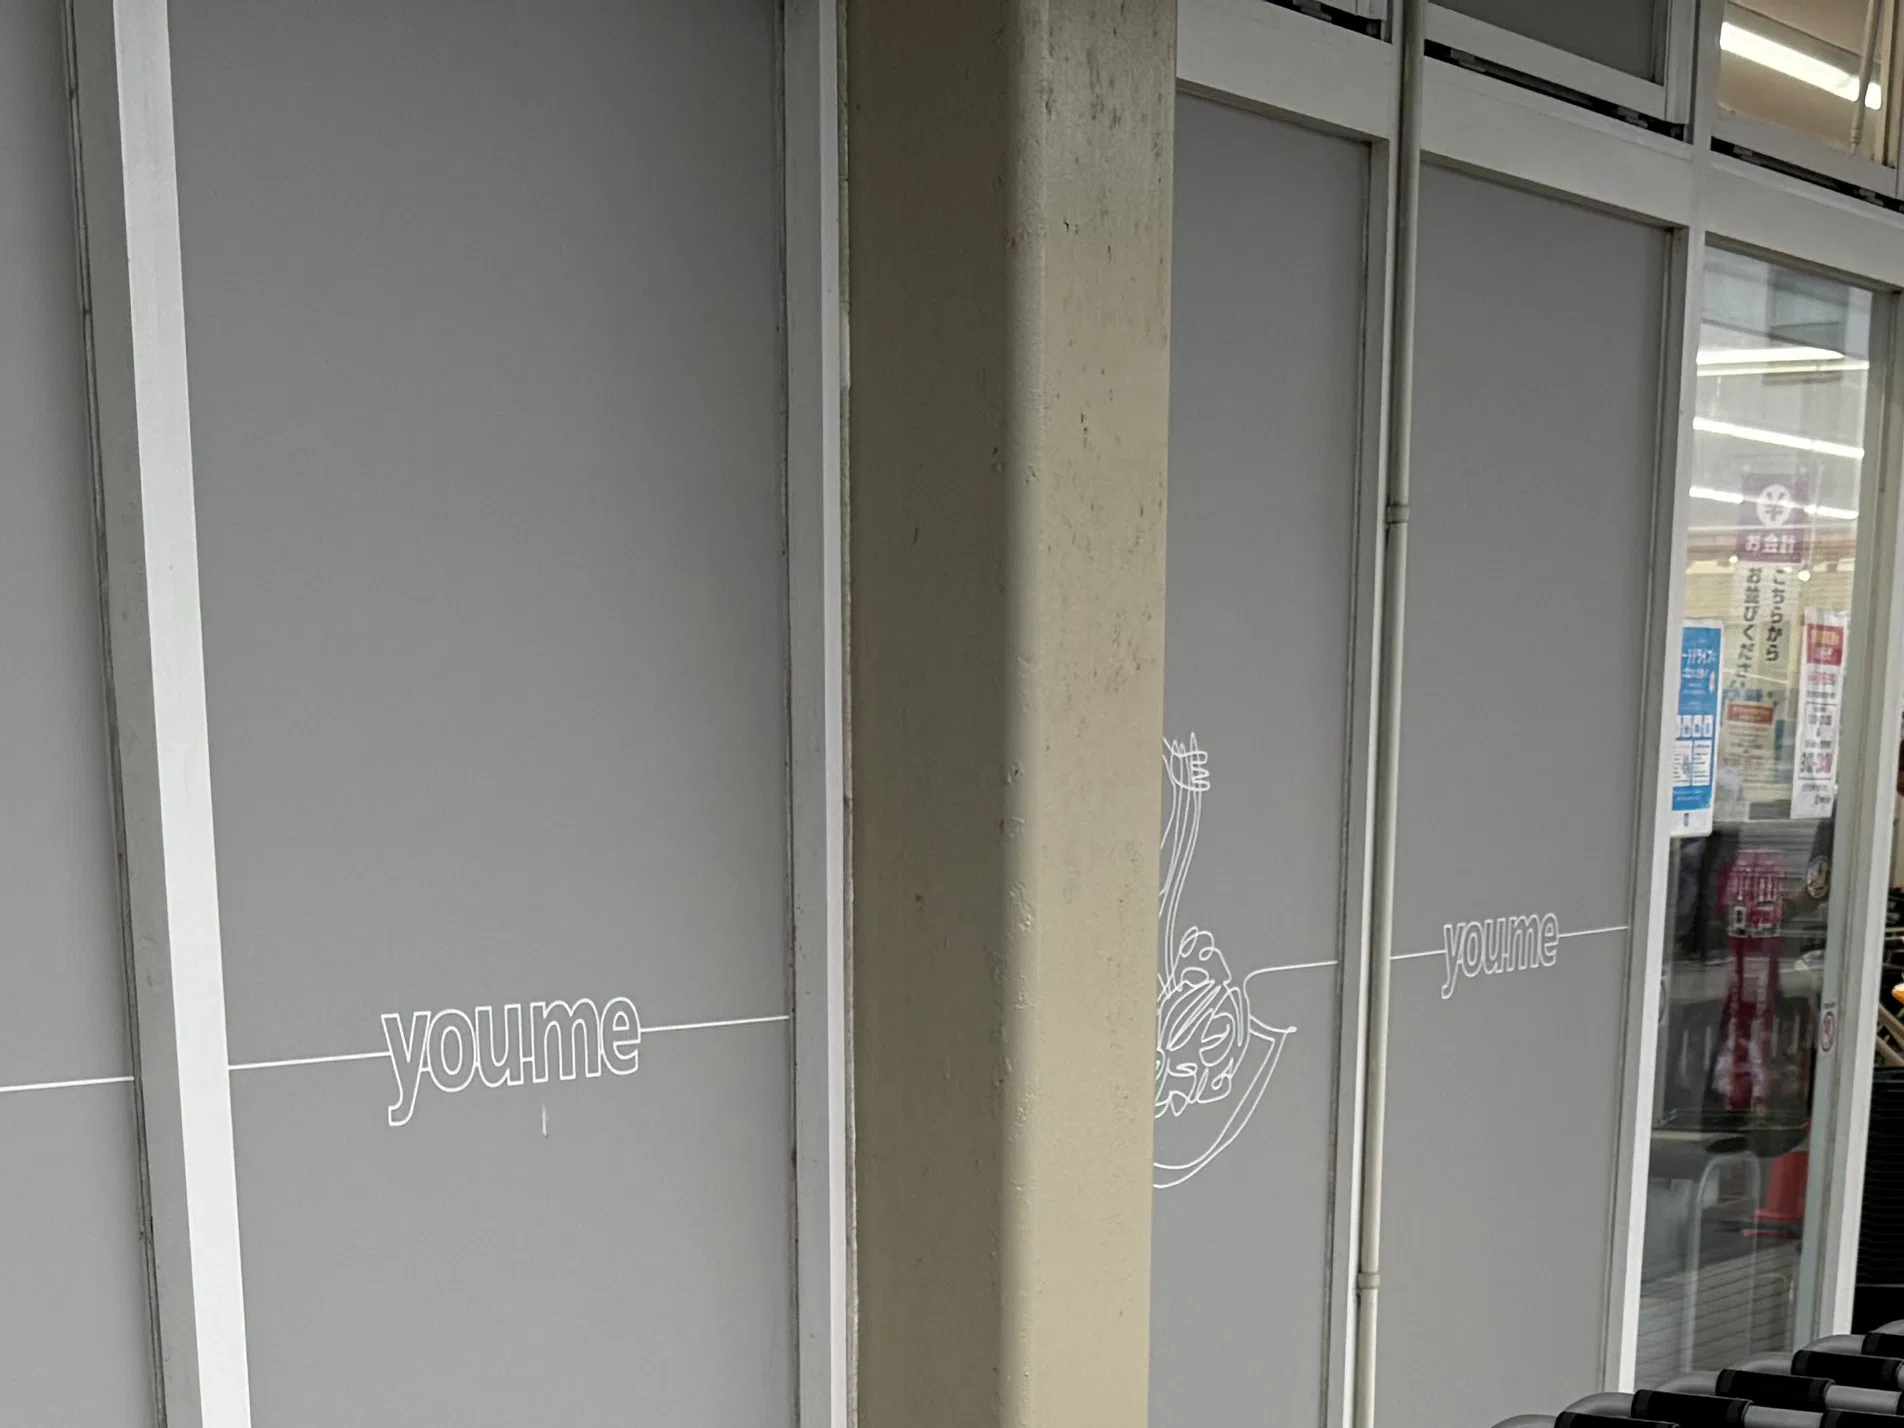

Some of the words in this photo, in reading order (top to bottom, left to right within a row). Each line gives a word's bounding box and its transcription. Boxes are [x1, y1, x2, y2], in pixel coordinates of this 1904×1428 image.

[1745, 534, 1796, 555] お会計
[1765, 568, 1787, 662] こちらから
[1441, 911, 1561, 1000] youme
[380, 996, 642, 1127] youme
